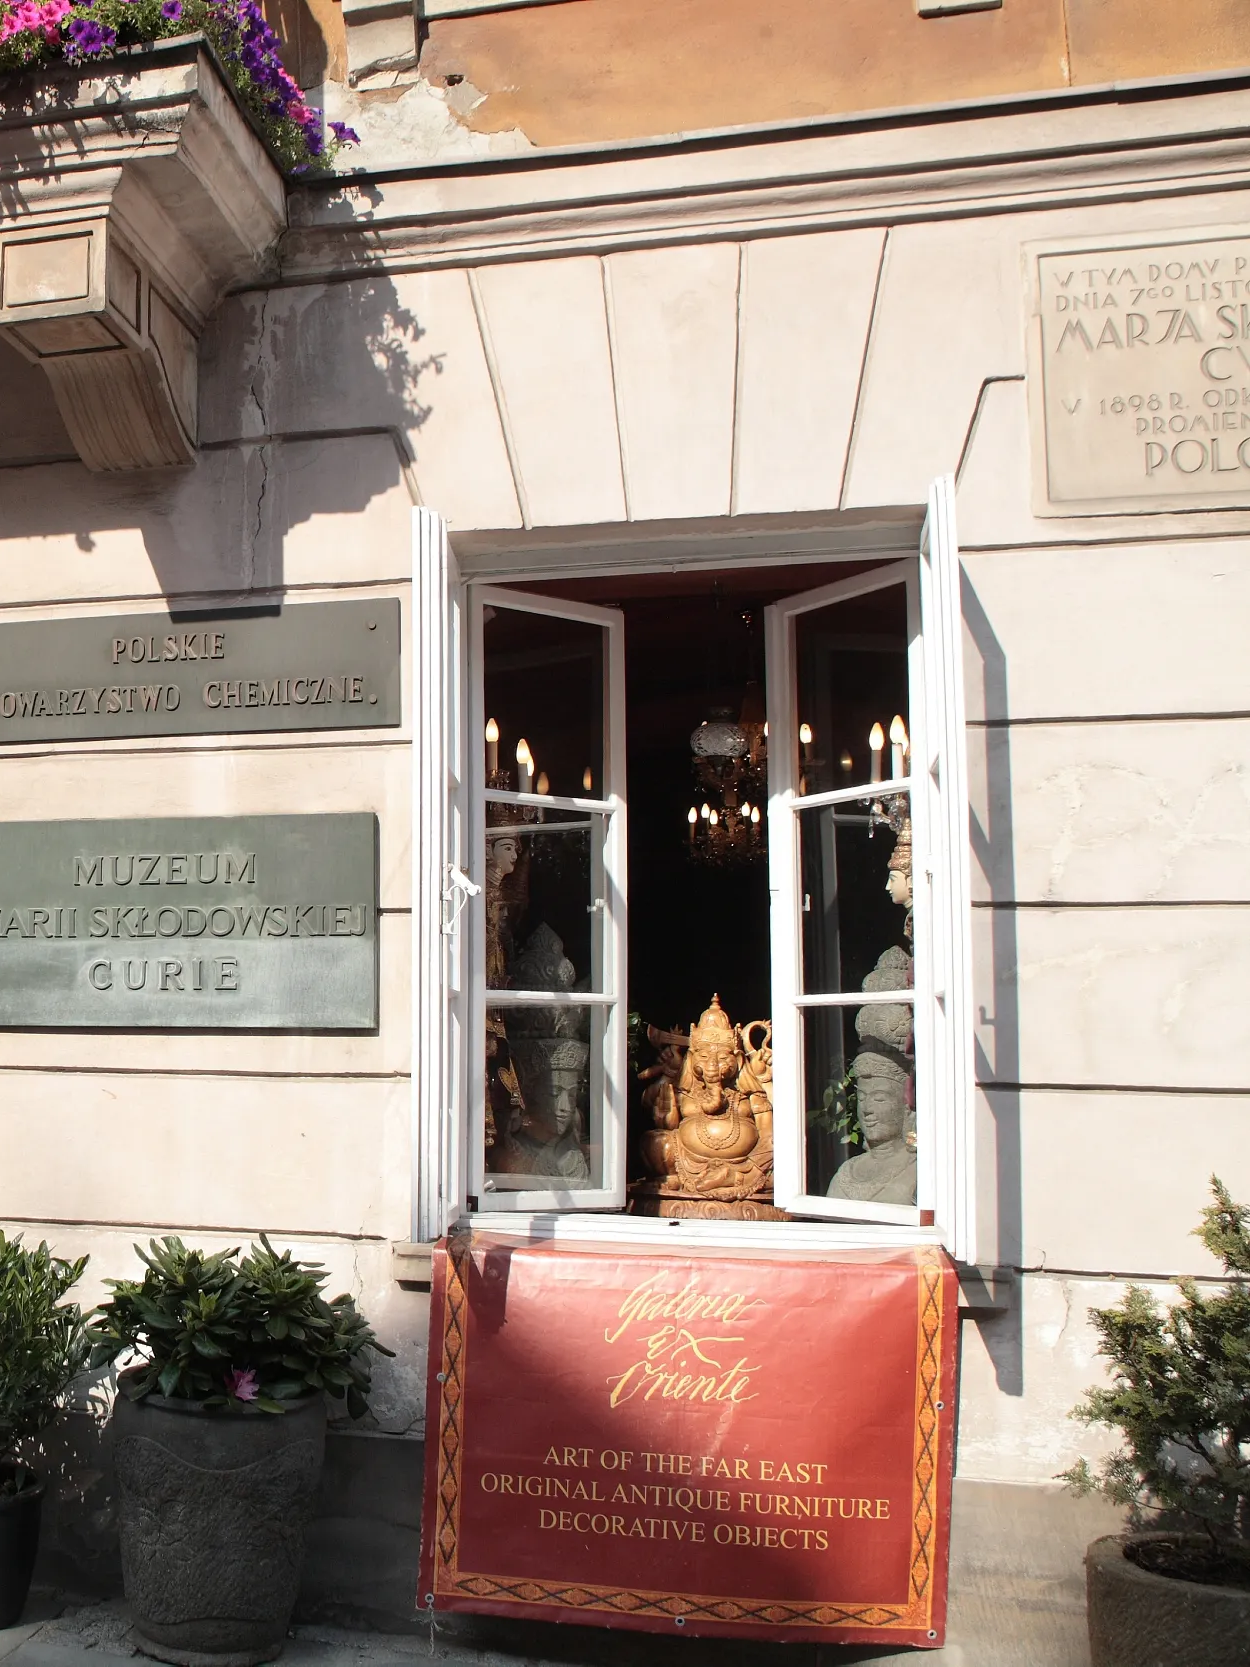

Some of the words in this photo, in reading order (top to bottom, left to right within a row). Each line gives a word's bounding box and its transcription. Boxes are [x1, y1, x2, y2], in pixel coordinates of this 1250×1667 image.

[1081, 267, 1138, 288] TYM
[1055, 292, 1119, 313] DNIA
[1185, 279, 1250, 302] LIST
[1100, 393, 1164, 416] 1898
[111, 632, 226, 664] POLSKIE
[202, 675, 364, 709] CHEMICZNE
[73, 852, 257, 887] MUZEUM
[89, 903, 368, 938] SKŁODOWSKIEJ
[88, 957, 239, 991] CURIE
[605, 1269, 767, 1344] Galeria
[606, 1357, 762, 1408] Oriente
[543, 1445, 594, 1468] ART
[600, 1449, 634, 1471] OF
[641, 1452, 693, 1475] THE
[700, 1456, 752, 1480] FAR
[759, 1460, 828, 1485] EAST
[481, 1472, 605, 1501] ORIGINAL
[611, 1483, 731, 1513] ANTIQUE
[738, 1491, 891, 1520] FURNITURE
[539, 1508, 706, 1544] DECORATIVE
[713, 1523, 829, 1551] OBJECTS
